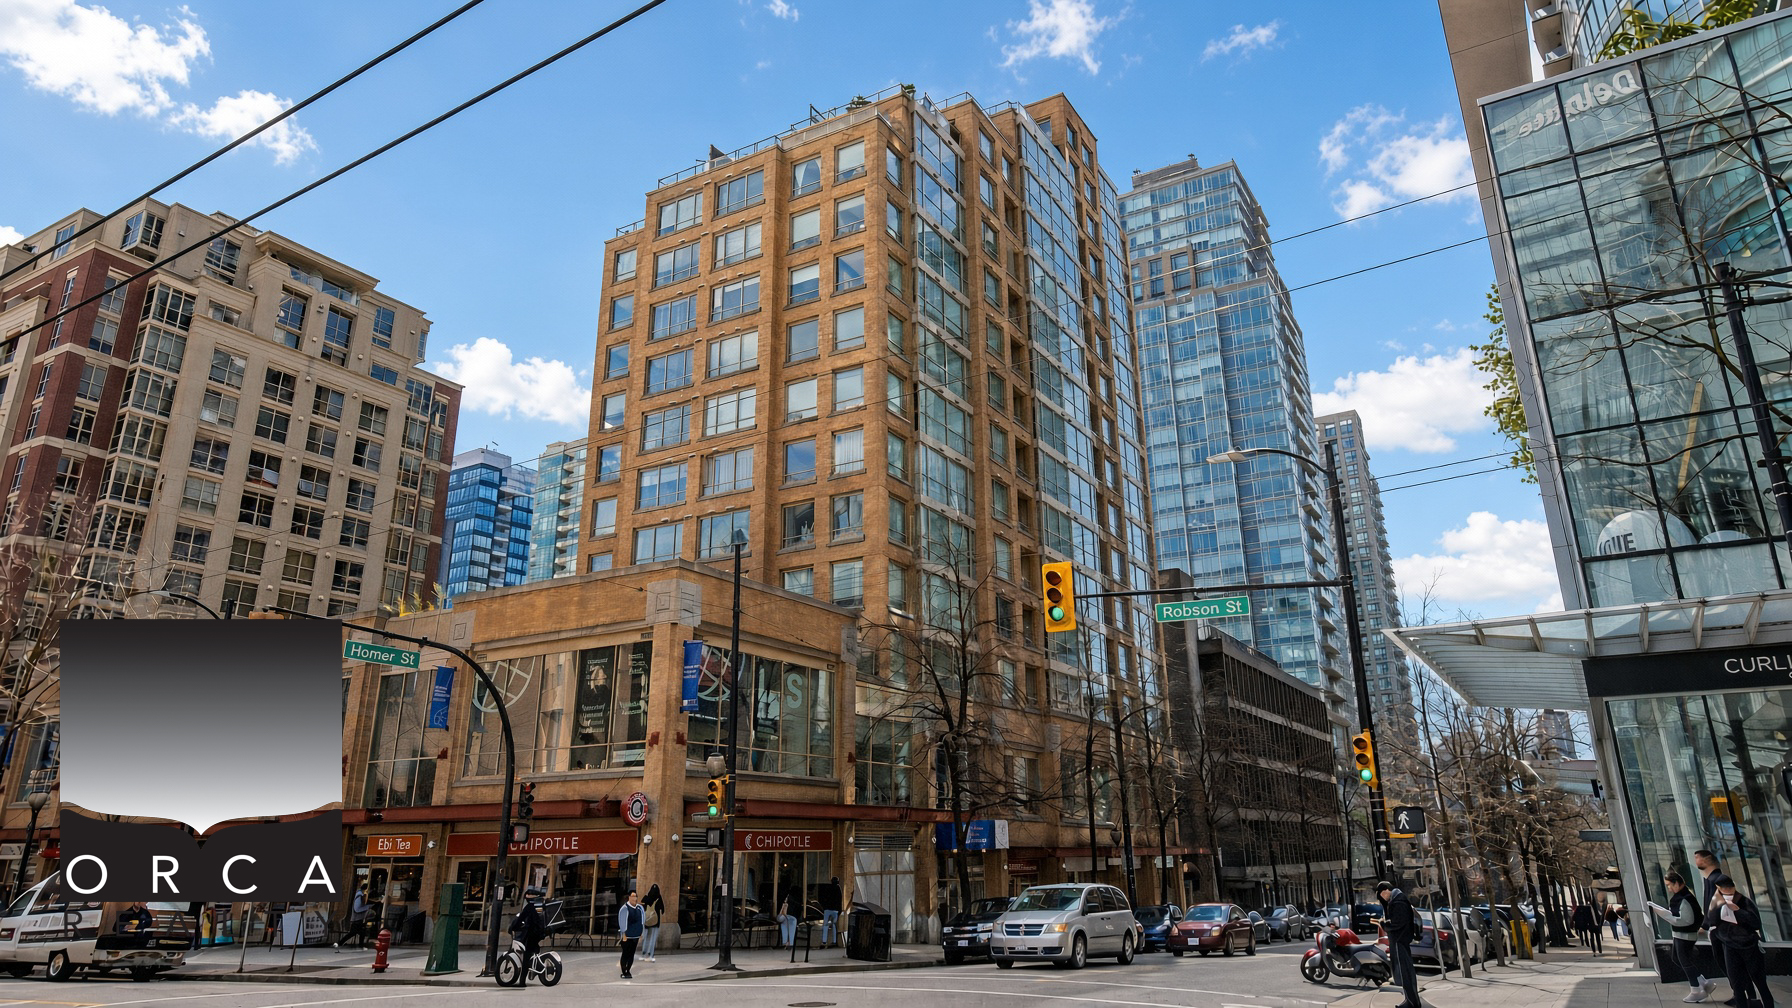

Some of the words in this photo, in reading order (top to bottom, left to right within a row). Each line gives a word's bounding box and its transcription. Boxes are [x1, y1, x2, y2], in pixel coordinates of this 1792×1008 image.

[1163, 603, 1220, 618] Robson
[1225, 600, 1243, 613] St
[350, 643, 396, 662] Homer
[400, 652, 415, 665] St
[378, 838, 393, 851] Ebi
[395, 838, 411, 850] Tea
[756, 835, 811, 848] CHIPOTLE
